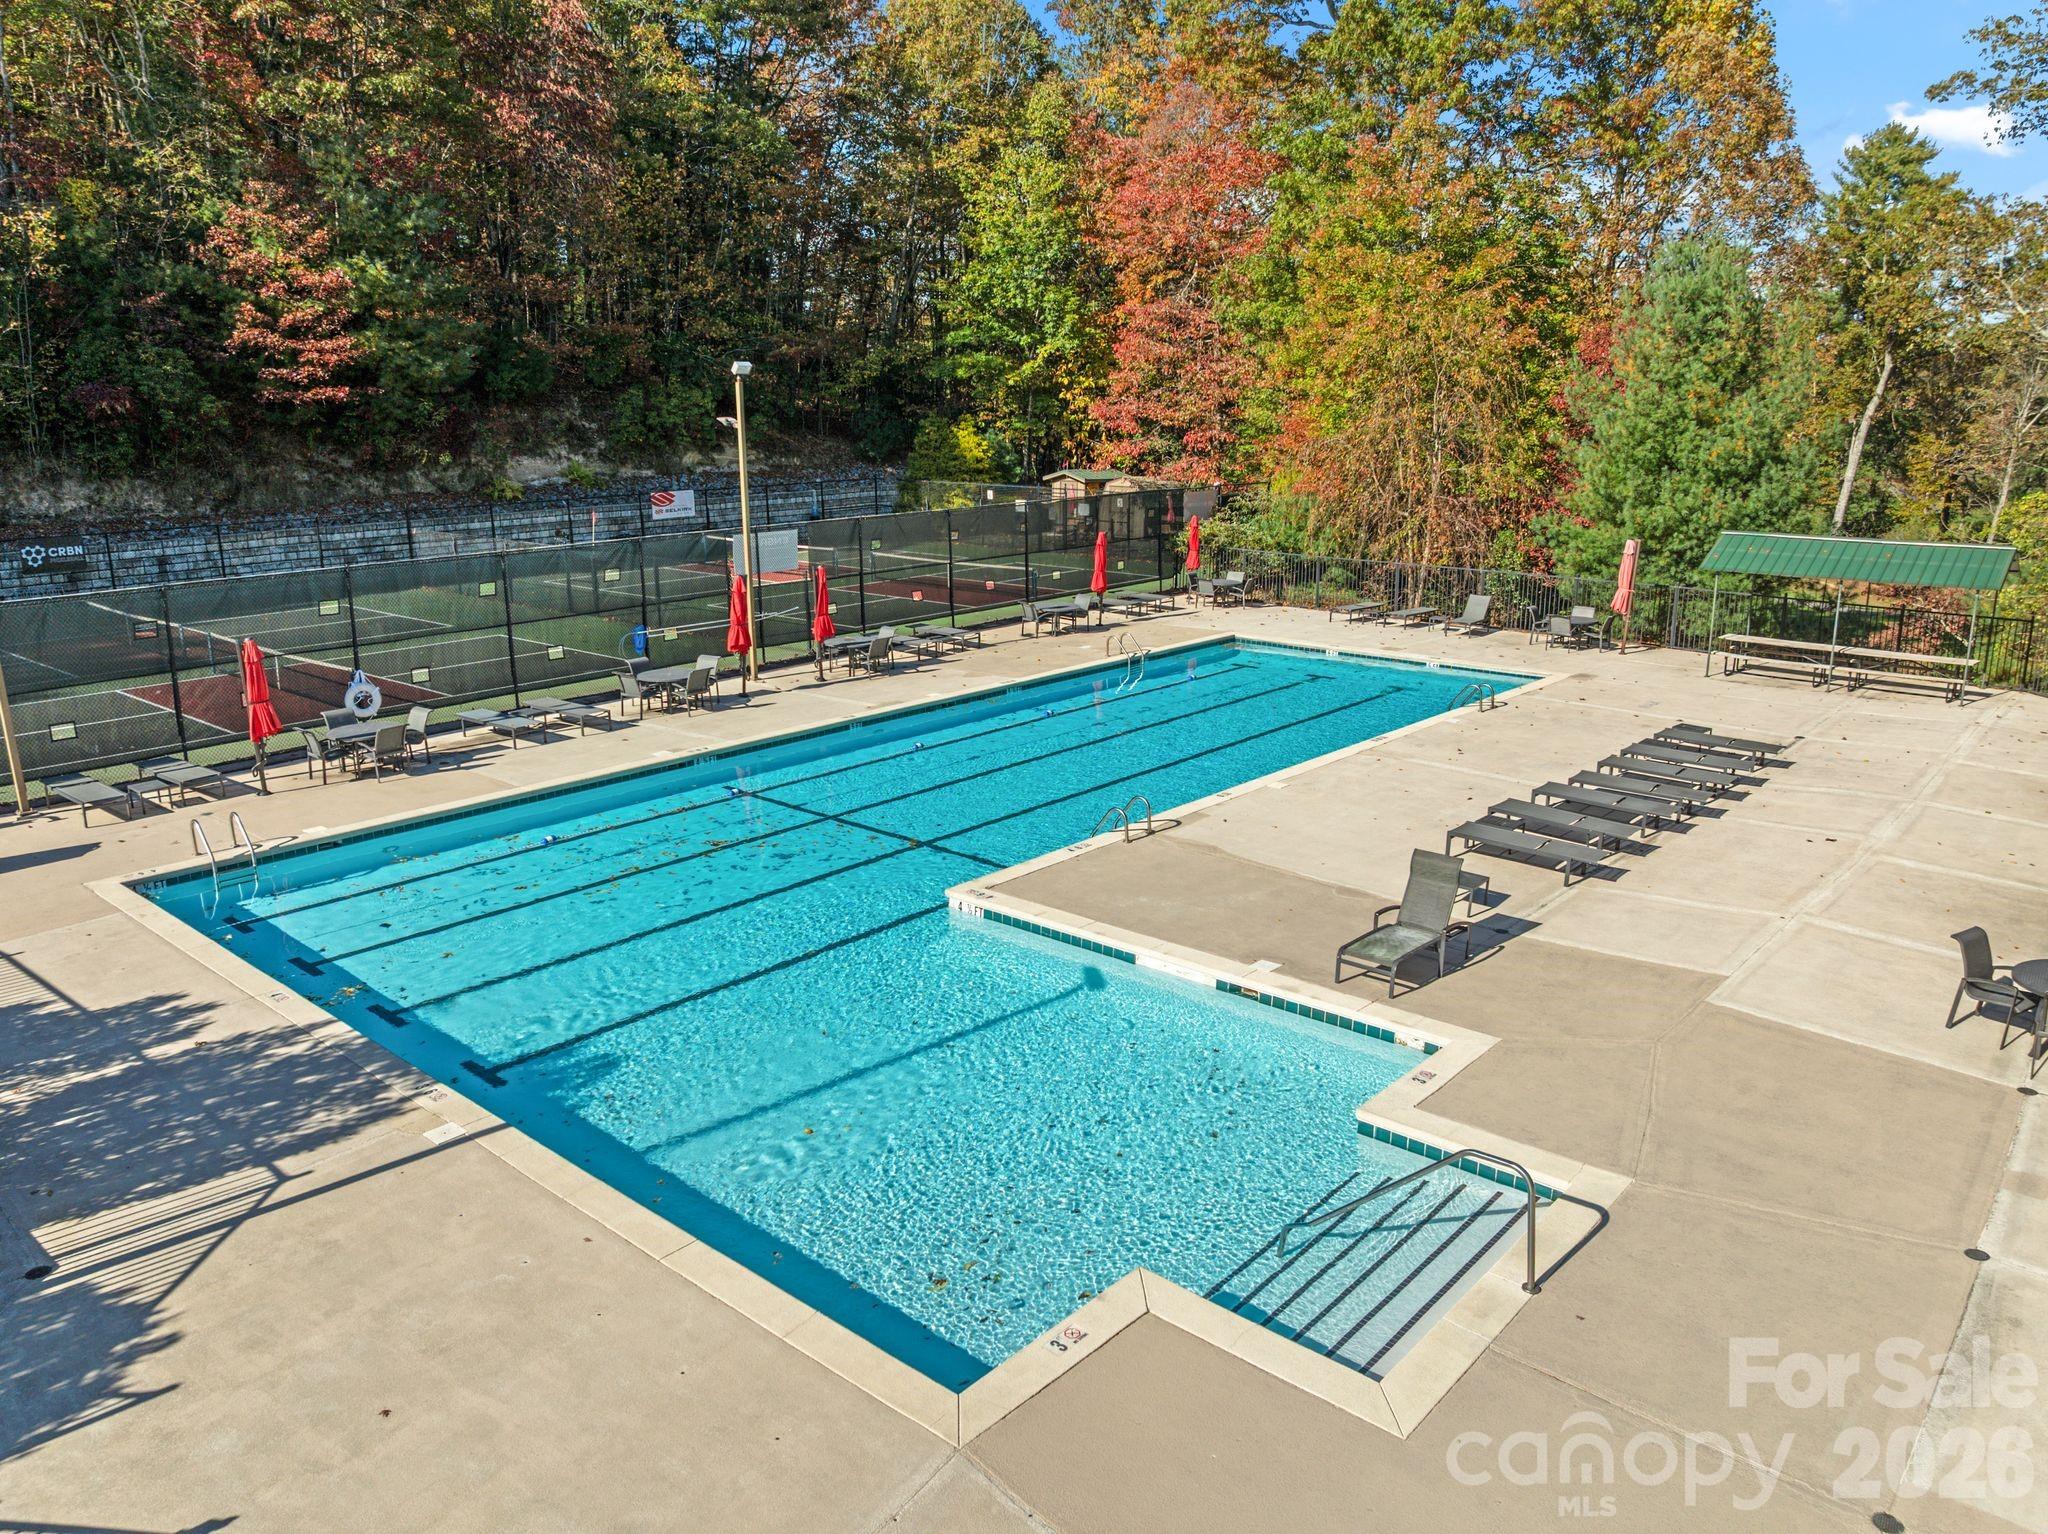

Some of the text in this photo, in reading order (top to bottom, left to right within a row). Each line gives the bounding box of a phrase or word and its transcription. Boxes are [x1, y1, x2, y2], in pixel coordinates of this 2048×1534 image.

[48, 545, 84, 557] CRBN
[974, 905, 984, 919] FT
[1050, 1340, 1068, 1352] 3
